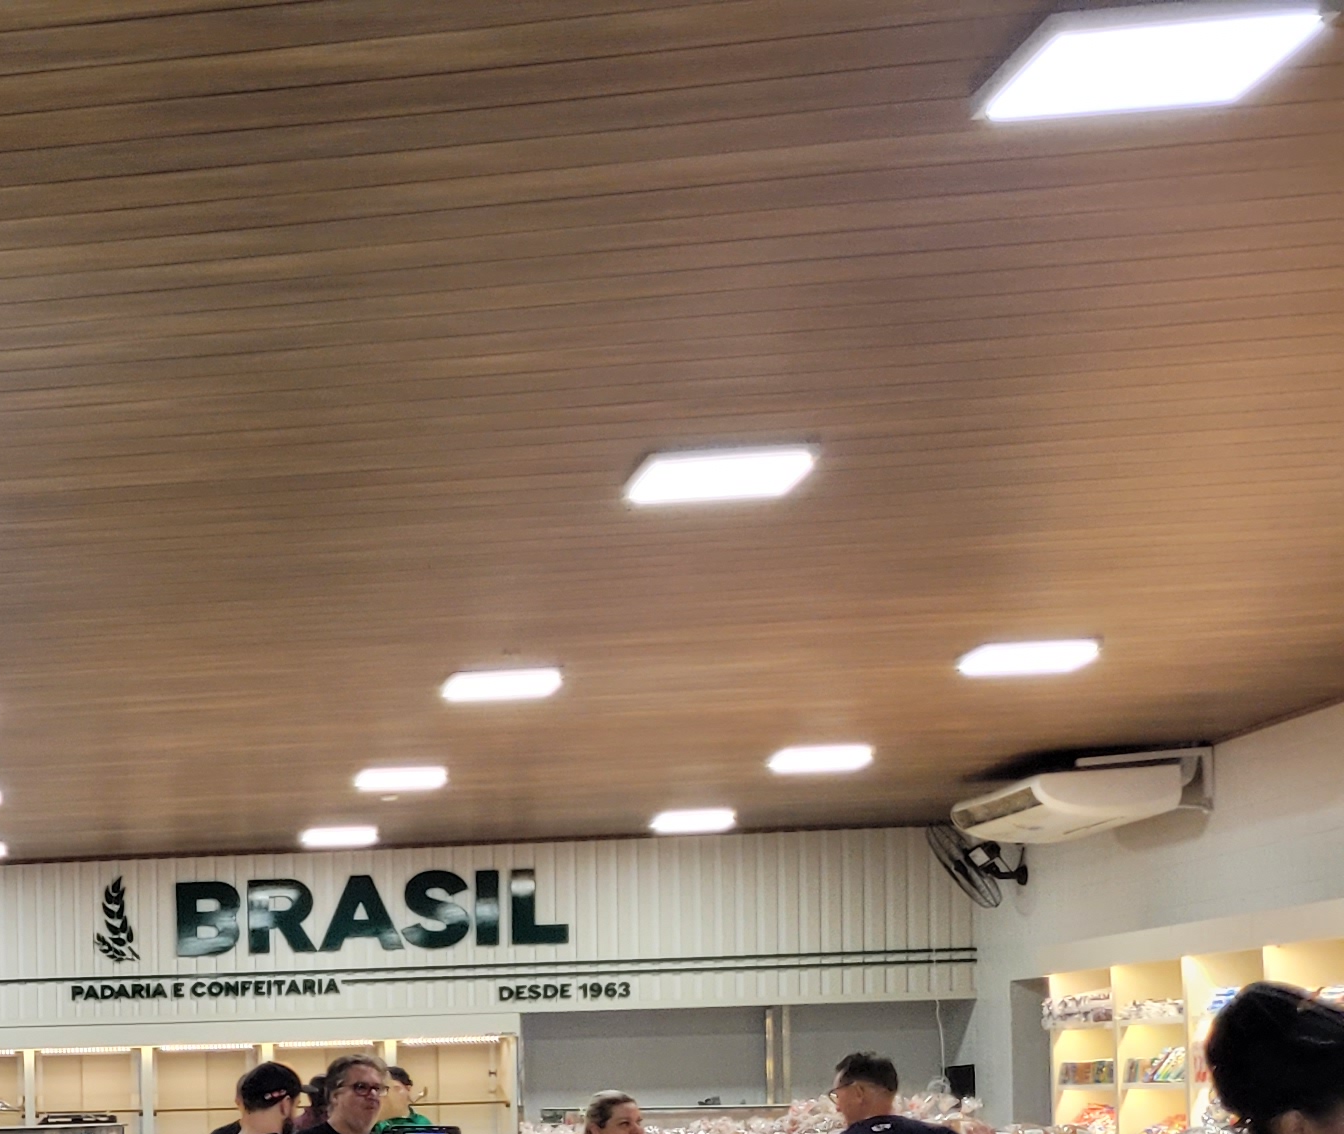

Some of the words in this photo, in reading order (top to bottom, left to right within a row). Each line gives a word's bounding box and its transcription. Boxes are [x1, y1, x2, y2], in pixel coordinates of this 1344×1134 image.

[175, 868, 570, 958] BRASIL
[70, 981, 168, 1001] PADARIA
[173, 982, 185, 998] E
[191, 978, 341, 997] CONFEITARIA
[498, 983, 572, 1001] DESDE
[578, 981, 631, 999] 1963
